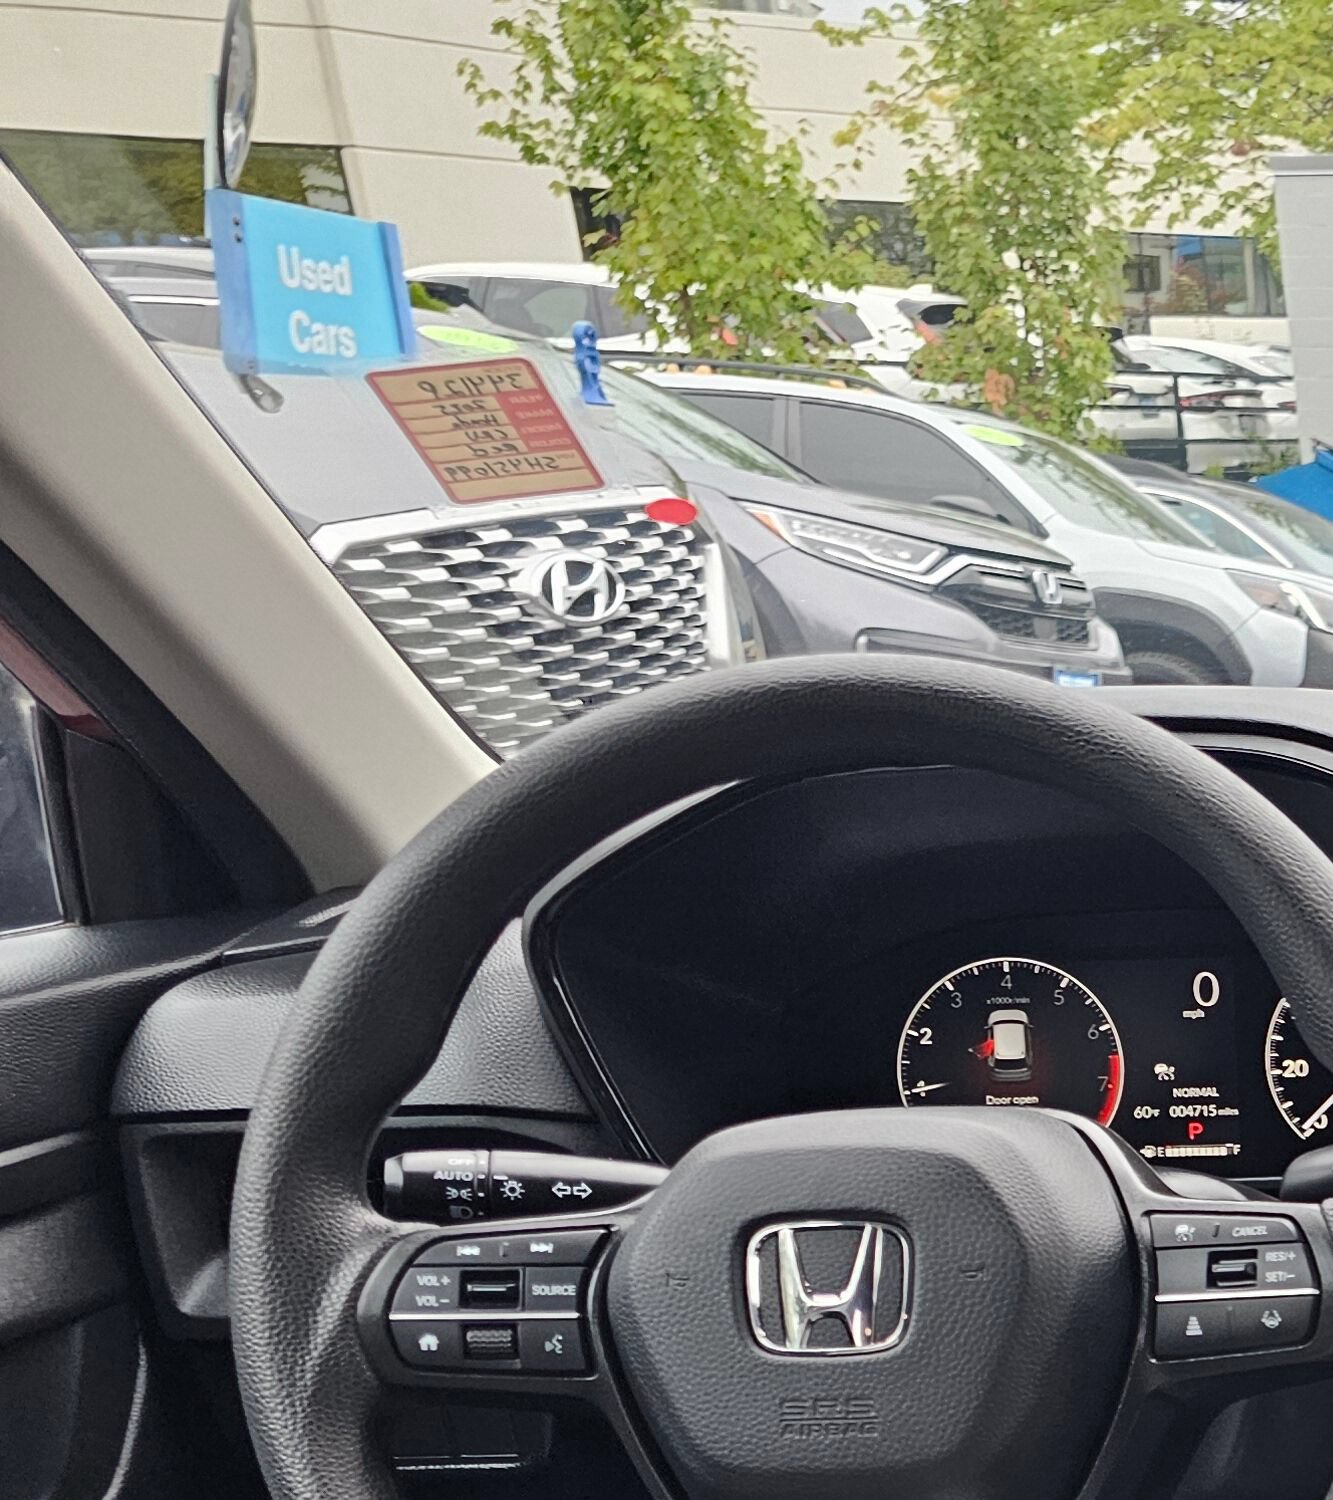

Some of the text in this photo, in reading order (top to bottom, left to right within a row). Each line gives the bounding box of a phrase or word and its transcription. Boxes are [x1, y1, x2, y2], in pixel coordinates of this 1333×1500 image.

[278, 244, 352, 295] Used
[289, 309, 357, 357] Cars
[1000, 974, 1013, 990] 4
[1192, 971, 1220, 1007] 0
[950, 992, 963, 1009] 3
[1053, 989, 1065, 1006] 5
[919, 1027, 933, 1045] 2
[1087, 1023, 1099, 1040] 6
[1282, 1059, 1310, 1078] 20
[1097, 1076, 1109, 1094] 7
[1172, 1087, 1220, 1098] NORMAL
[986, 1095, 1040, 1106] Door open
[1169, 1104, 1217, 1118] 004715
[1188, 1122, 1204, 1140] P
[1157, 1144, 1241, 1158] E F
[448, 1158, 474, 1166] OFF
[433, 1171, 474, 1182] AUTO
[1232, 1226, 1268, 1237] CANCEL
[531, 1285, 577, 1296] SOURCE
[781, 1400, 876, 1418] SRS
[781, 1421, 879, 1438] AIRBAG
